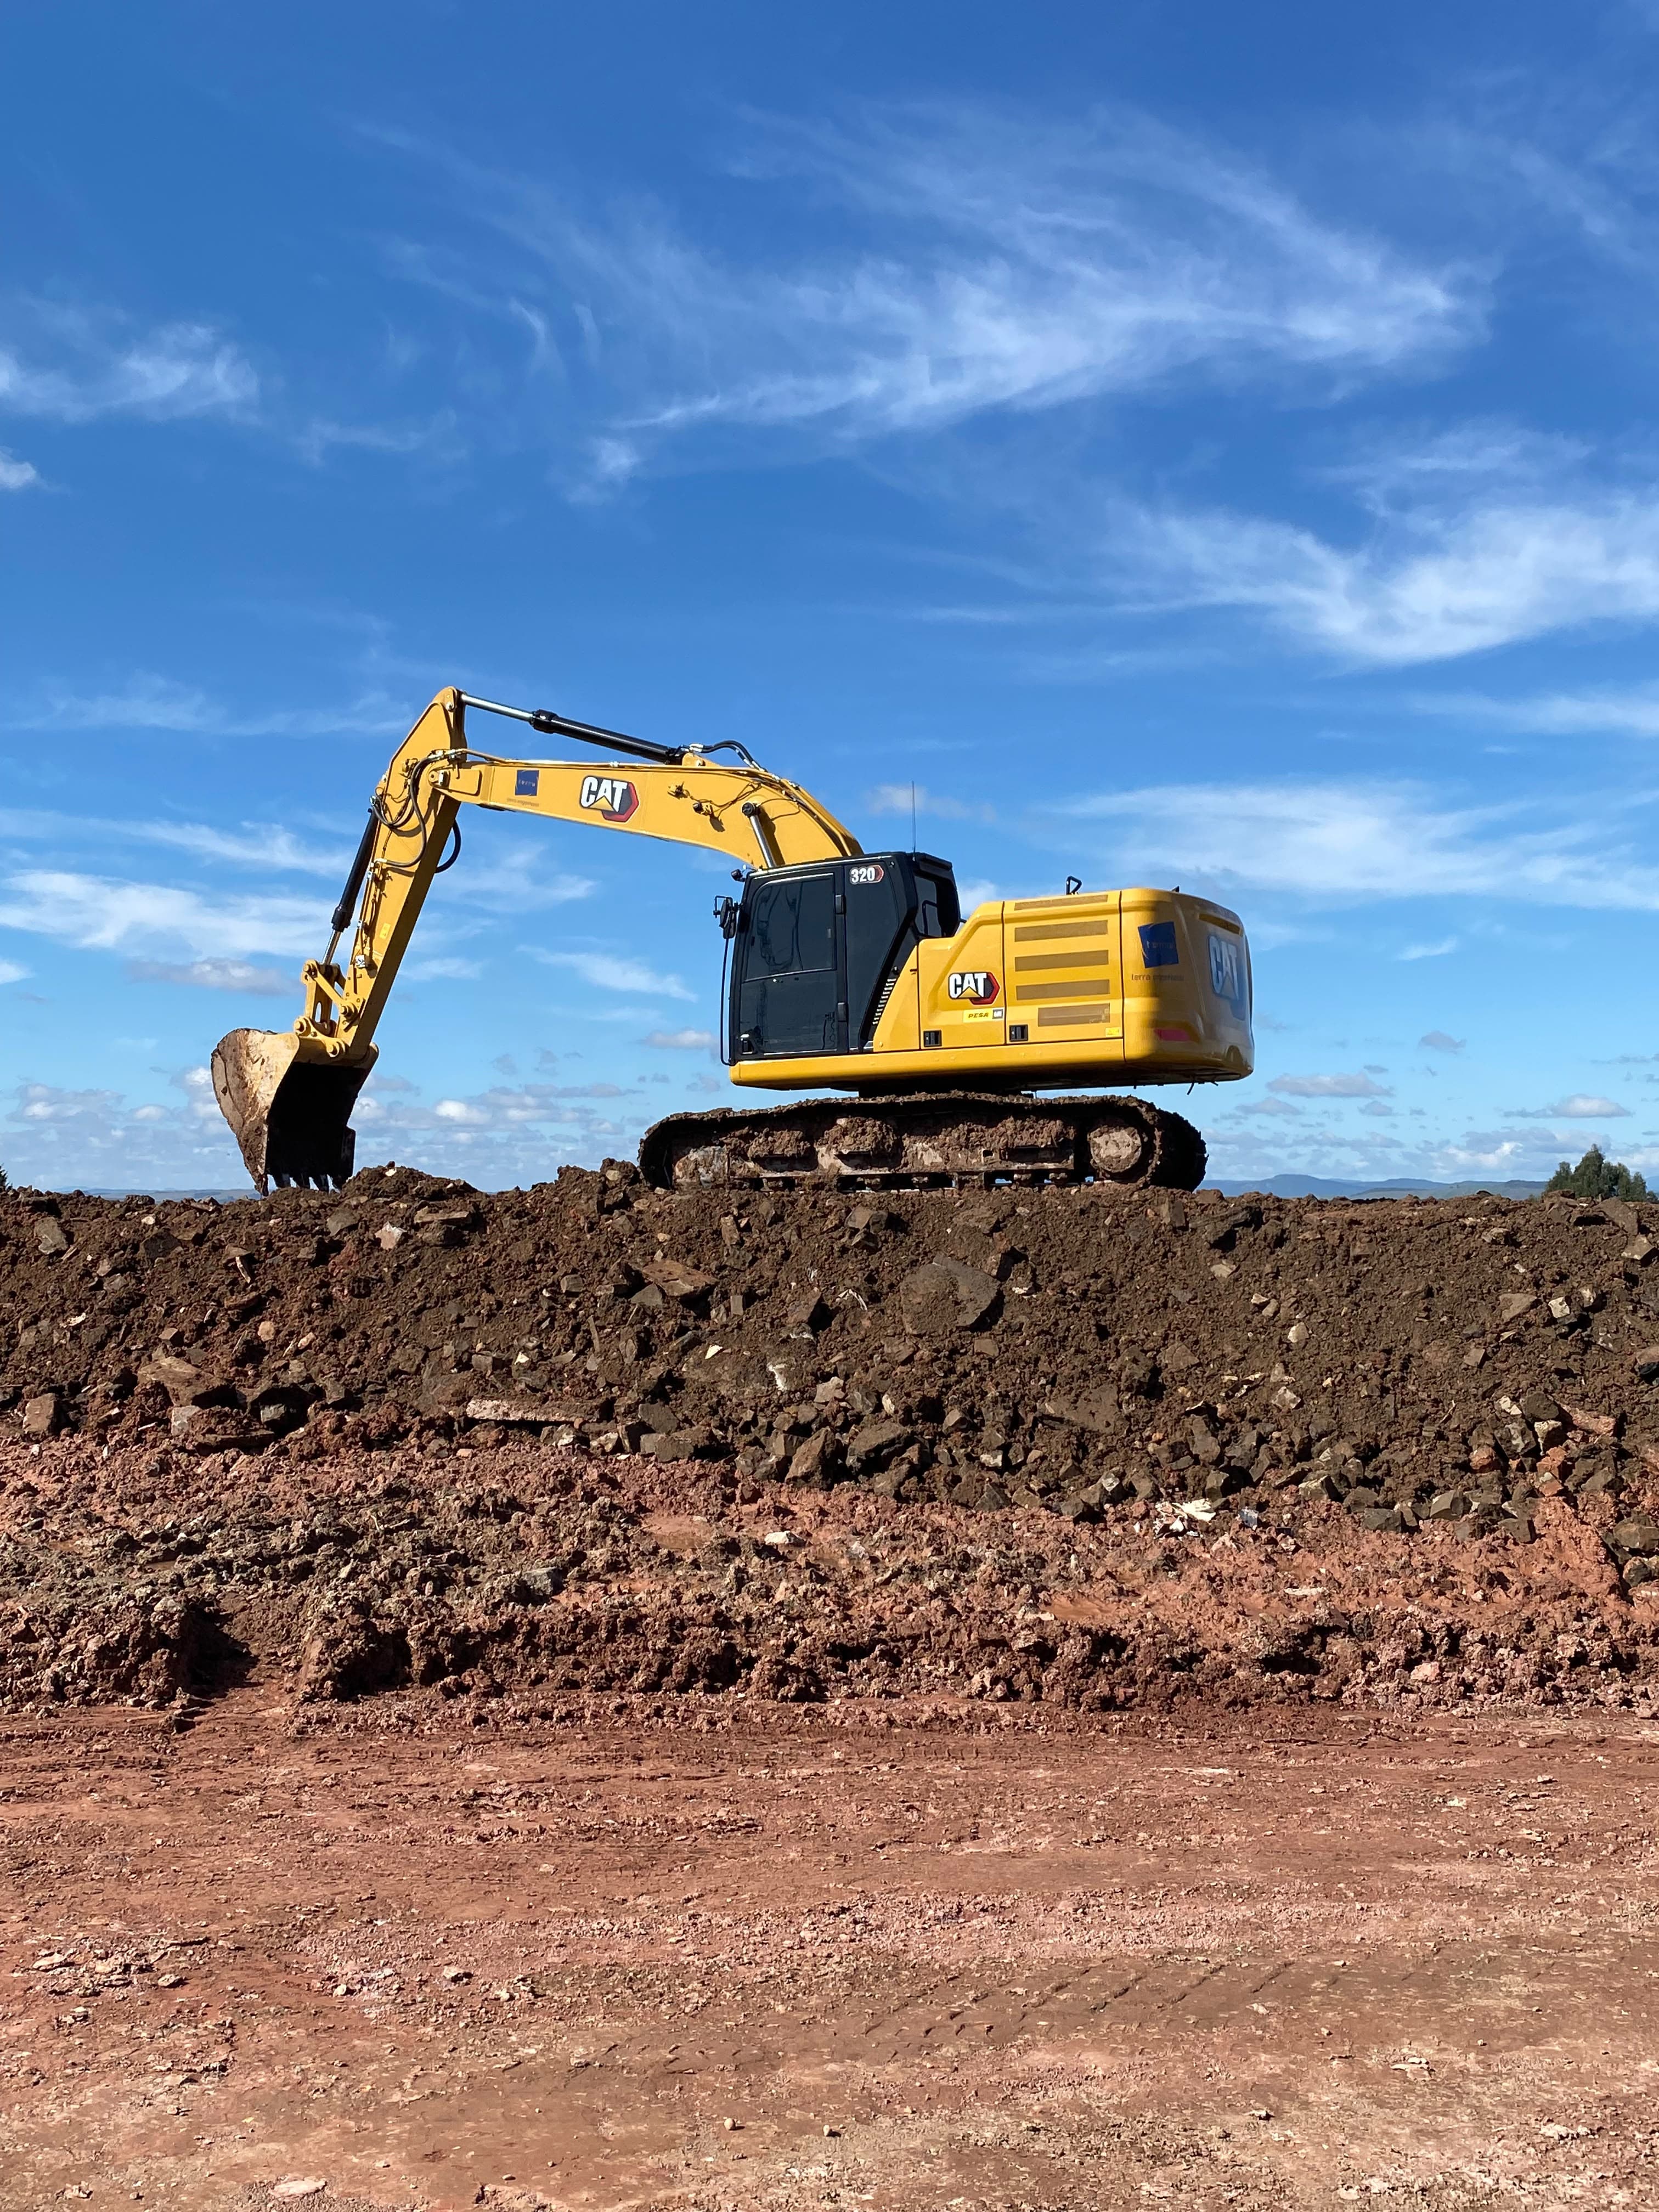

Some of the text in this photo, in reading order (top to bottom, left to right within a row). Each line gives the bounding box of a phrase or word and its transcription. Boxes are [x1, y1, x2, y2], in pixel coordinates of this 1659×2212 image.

[580, 776, 628, 812] CAT
[851, 867, 876, 883] 320
[1209, 935, 1239, 1001] CAT
[949, 972, 987, 998] CAT
